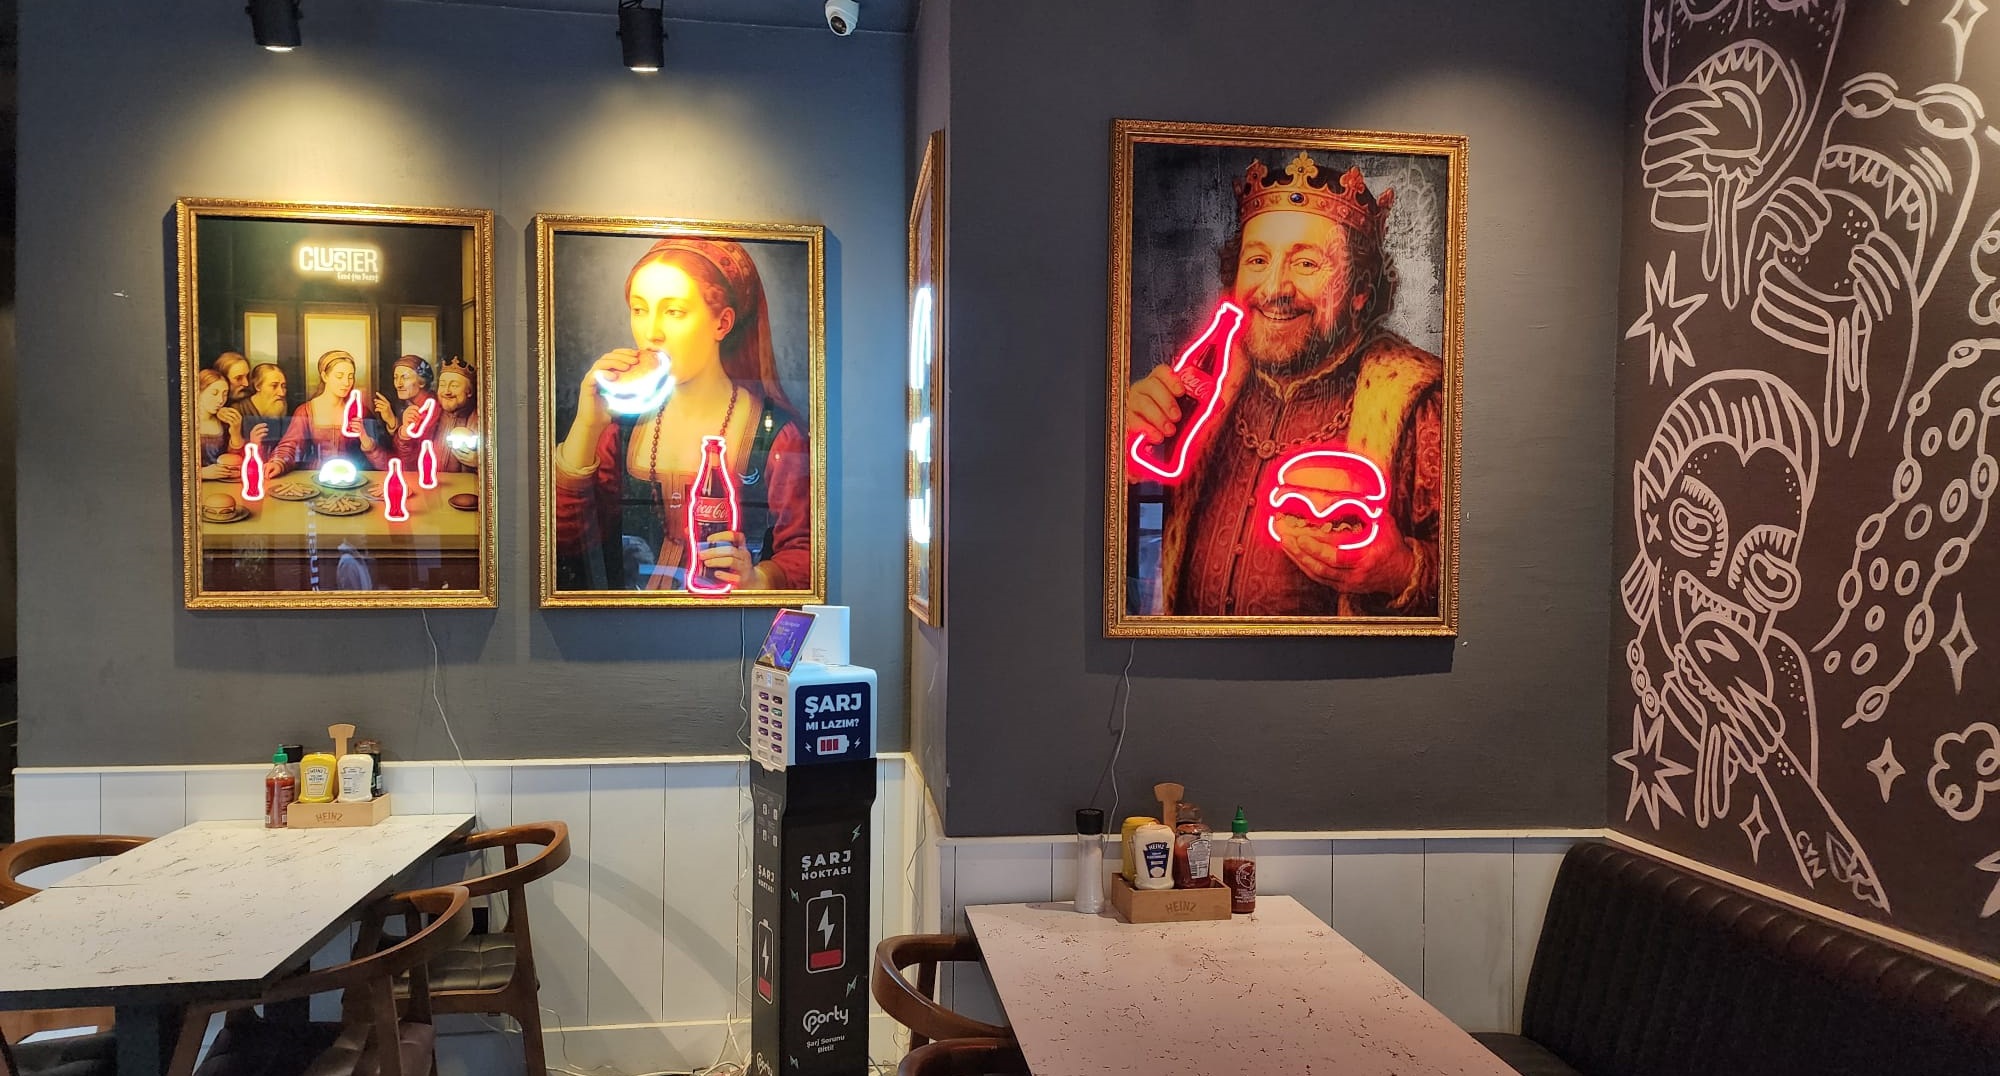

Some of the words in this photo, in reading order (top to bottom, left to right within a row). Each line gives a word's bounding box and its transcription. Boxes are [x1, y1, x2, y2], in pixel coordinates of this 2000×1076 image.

[299, 246, 378, 272] CLUSTER
[804, 693, 862, 719] ŞARJ
[805, 721, 819, 731] MI
[821, 718, 860, 730] LAZIM?
[315, 811, 343, 823] HEINZ
[801, 849, 852, 872] ŞARJ
[801, 866, 852, 881] NOKTASI
[1165, 900, 1197, 914] HEINZ
